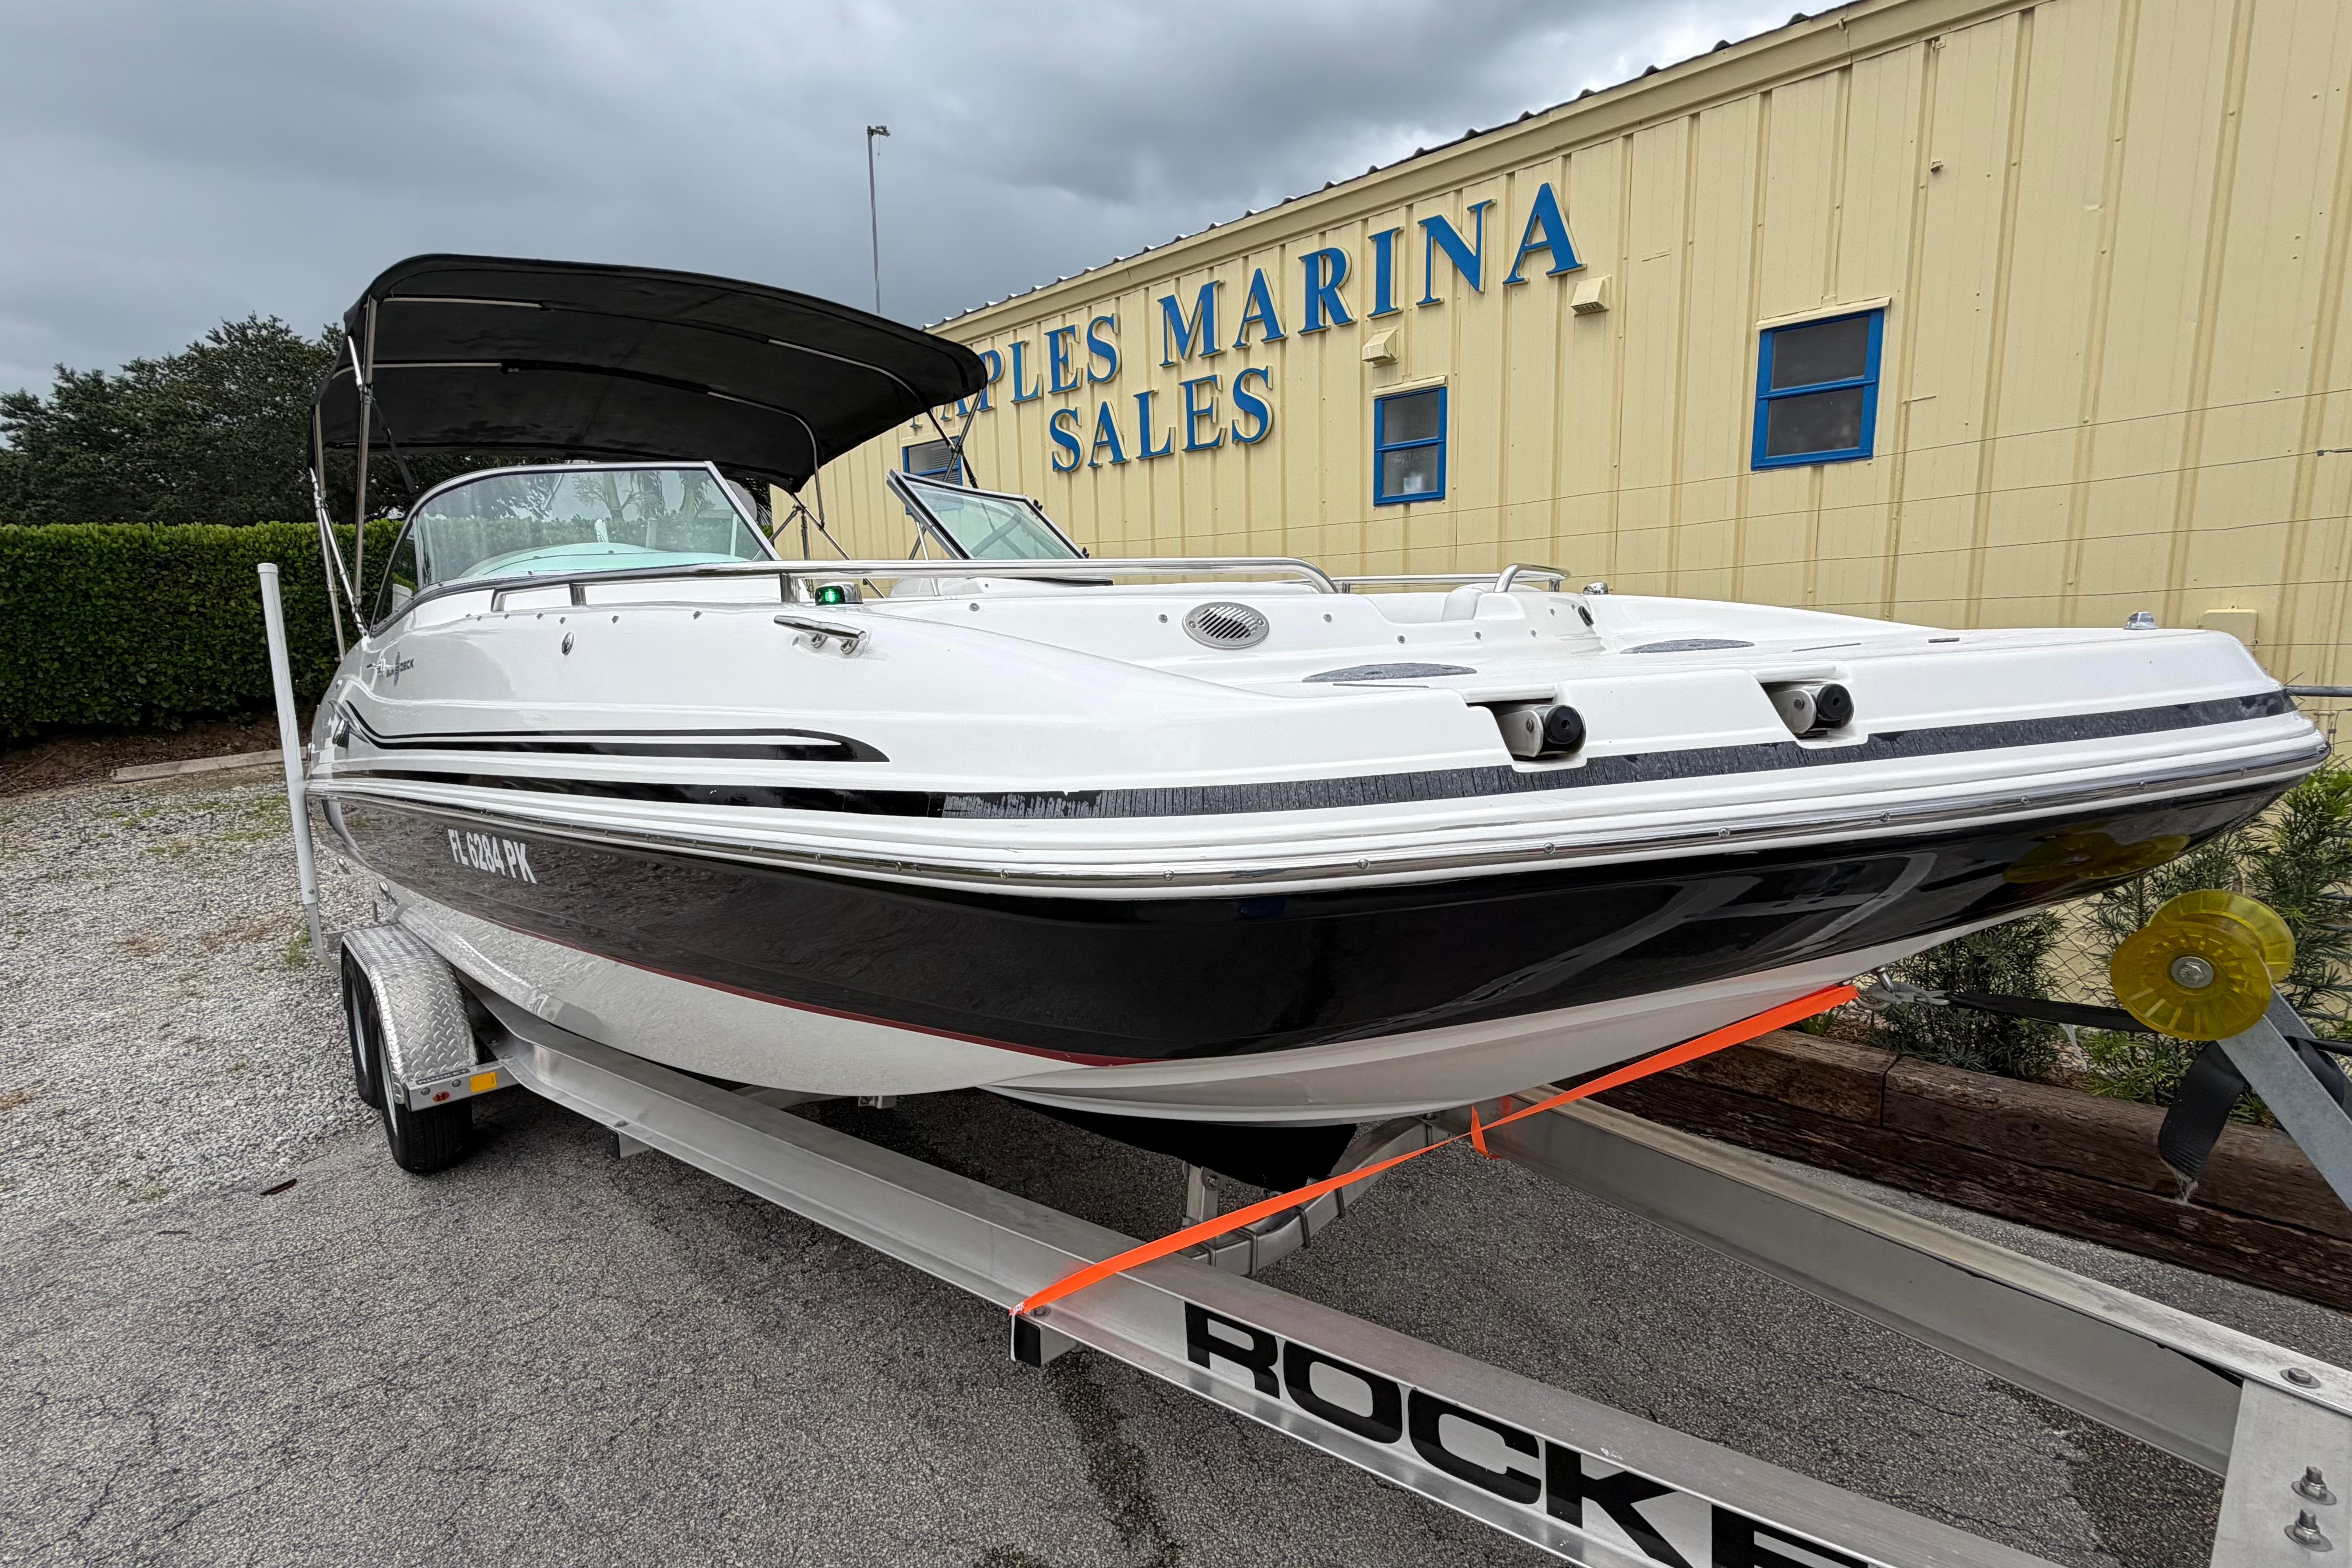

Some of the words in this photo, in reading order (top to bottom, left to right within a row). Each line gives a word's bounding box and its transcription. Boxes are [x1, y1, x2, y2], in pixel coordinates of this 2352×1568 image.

[910, 313, 1121, 429] PLES
[1157, 182, 1586, 367] MARINA
[1050, 366, 1273, 472] SALES
[448, 829, 469, 866] FL
[466, 832, 506, 876] 6284
[502, 839, 537, 884] PK
[1184, 1301, 1885, 1568] ROCKE
